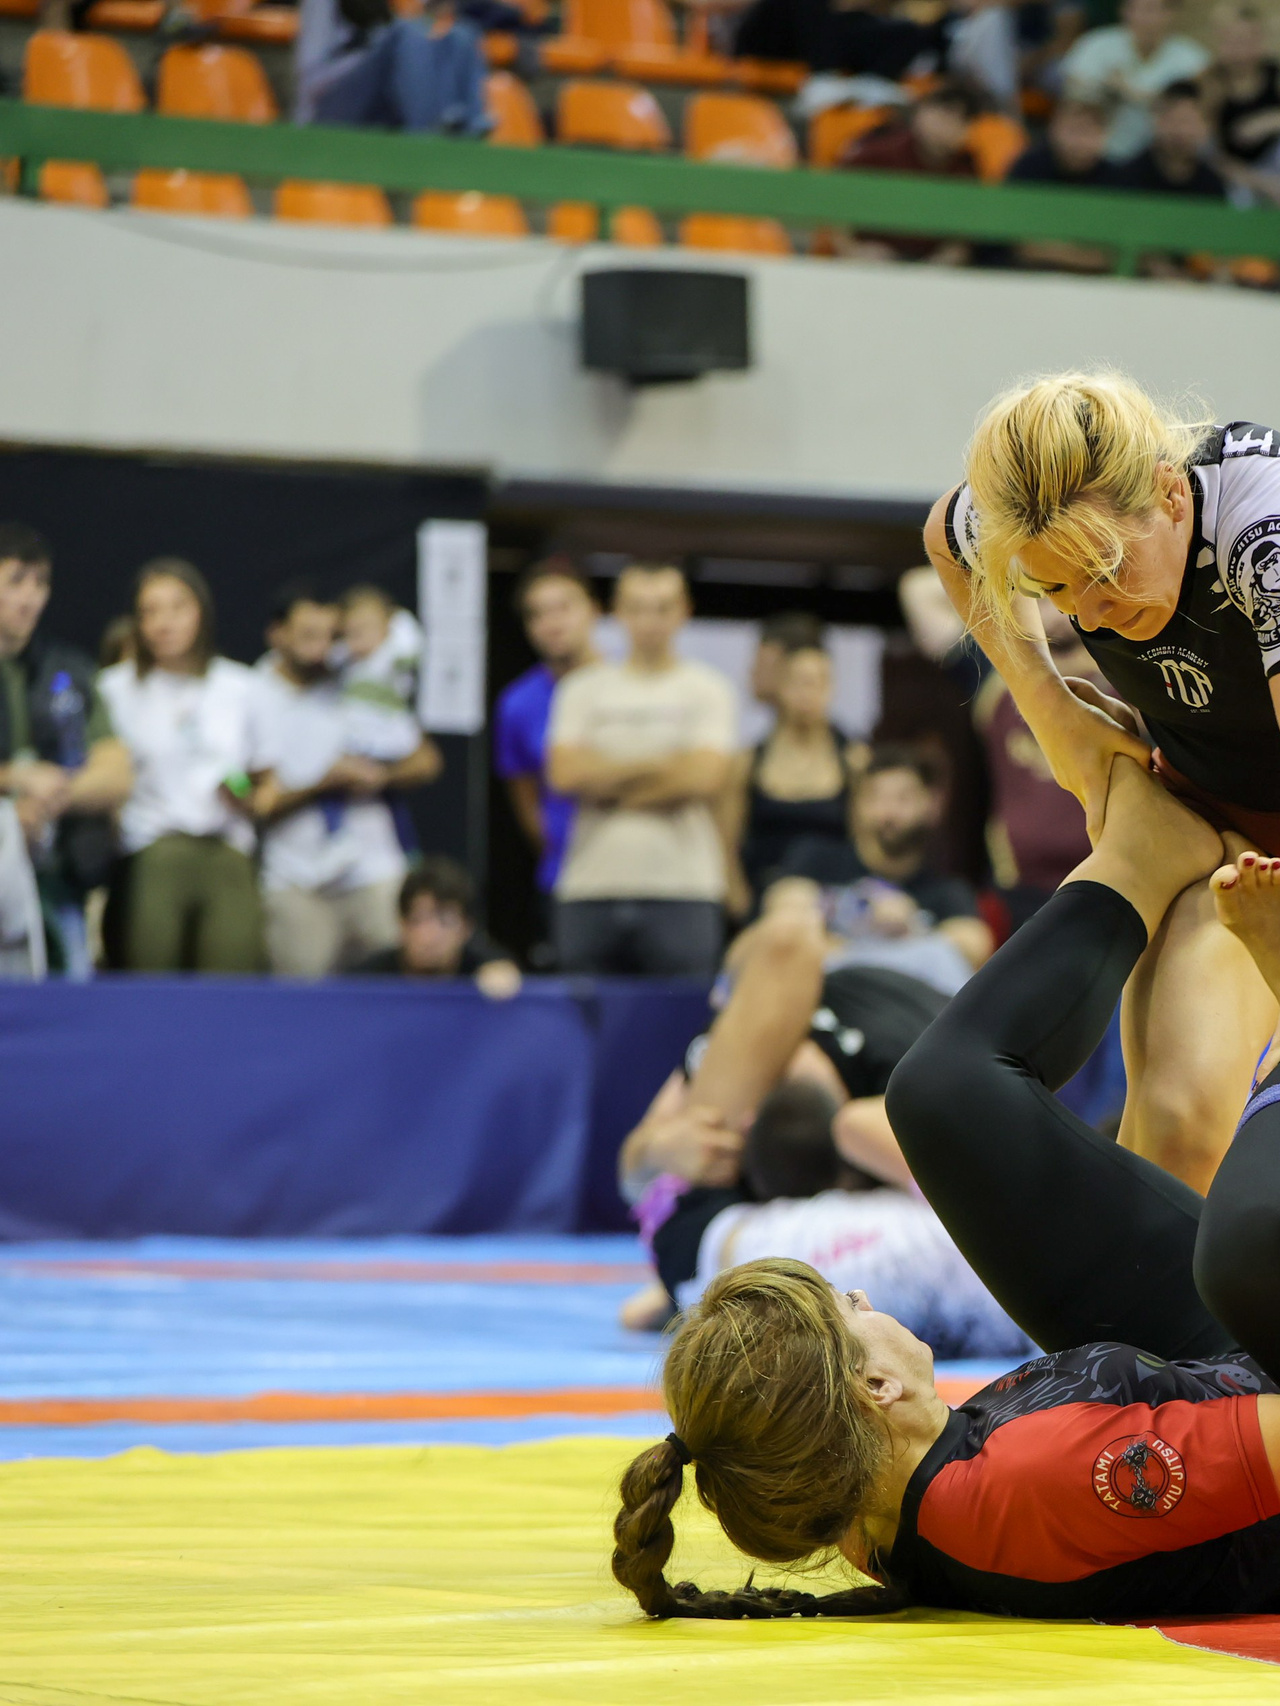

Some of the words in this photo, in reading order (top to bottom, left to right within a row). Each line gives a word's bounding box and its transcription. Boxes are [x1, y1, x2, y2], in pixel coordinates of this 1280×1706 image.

[1146, 645, 1176, 659] COMBAT
[1176, 647, 1209, 668] ACADEMY
[1152, 1439, 1184, 1480] JITSU
[1095, 1451, 1121, 1510] TATAMI
[1163, 1484, 1182, 1510] JIU
